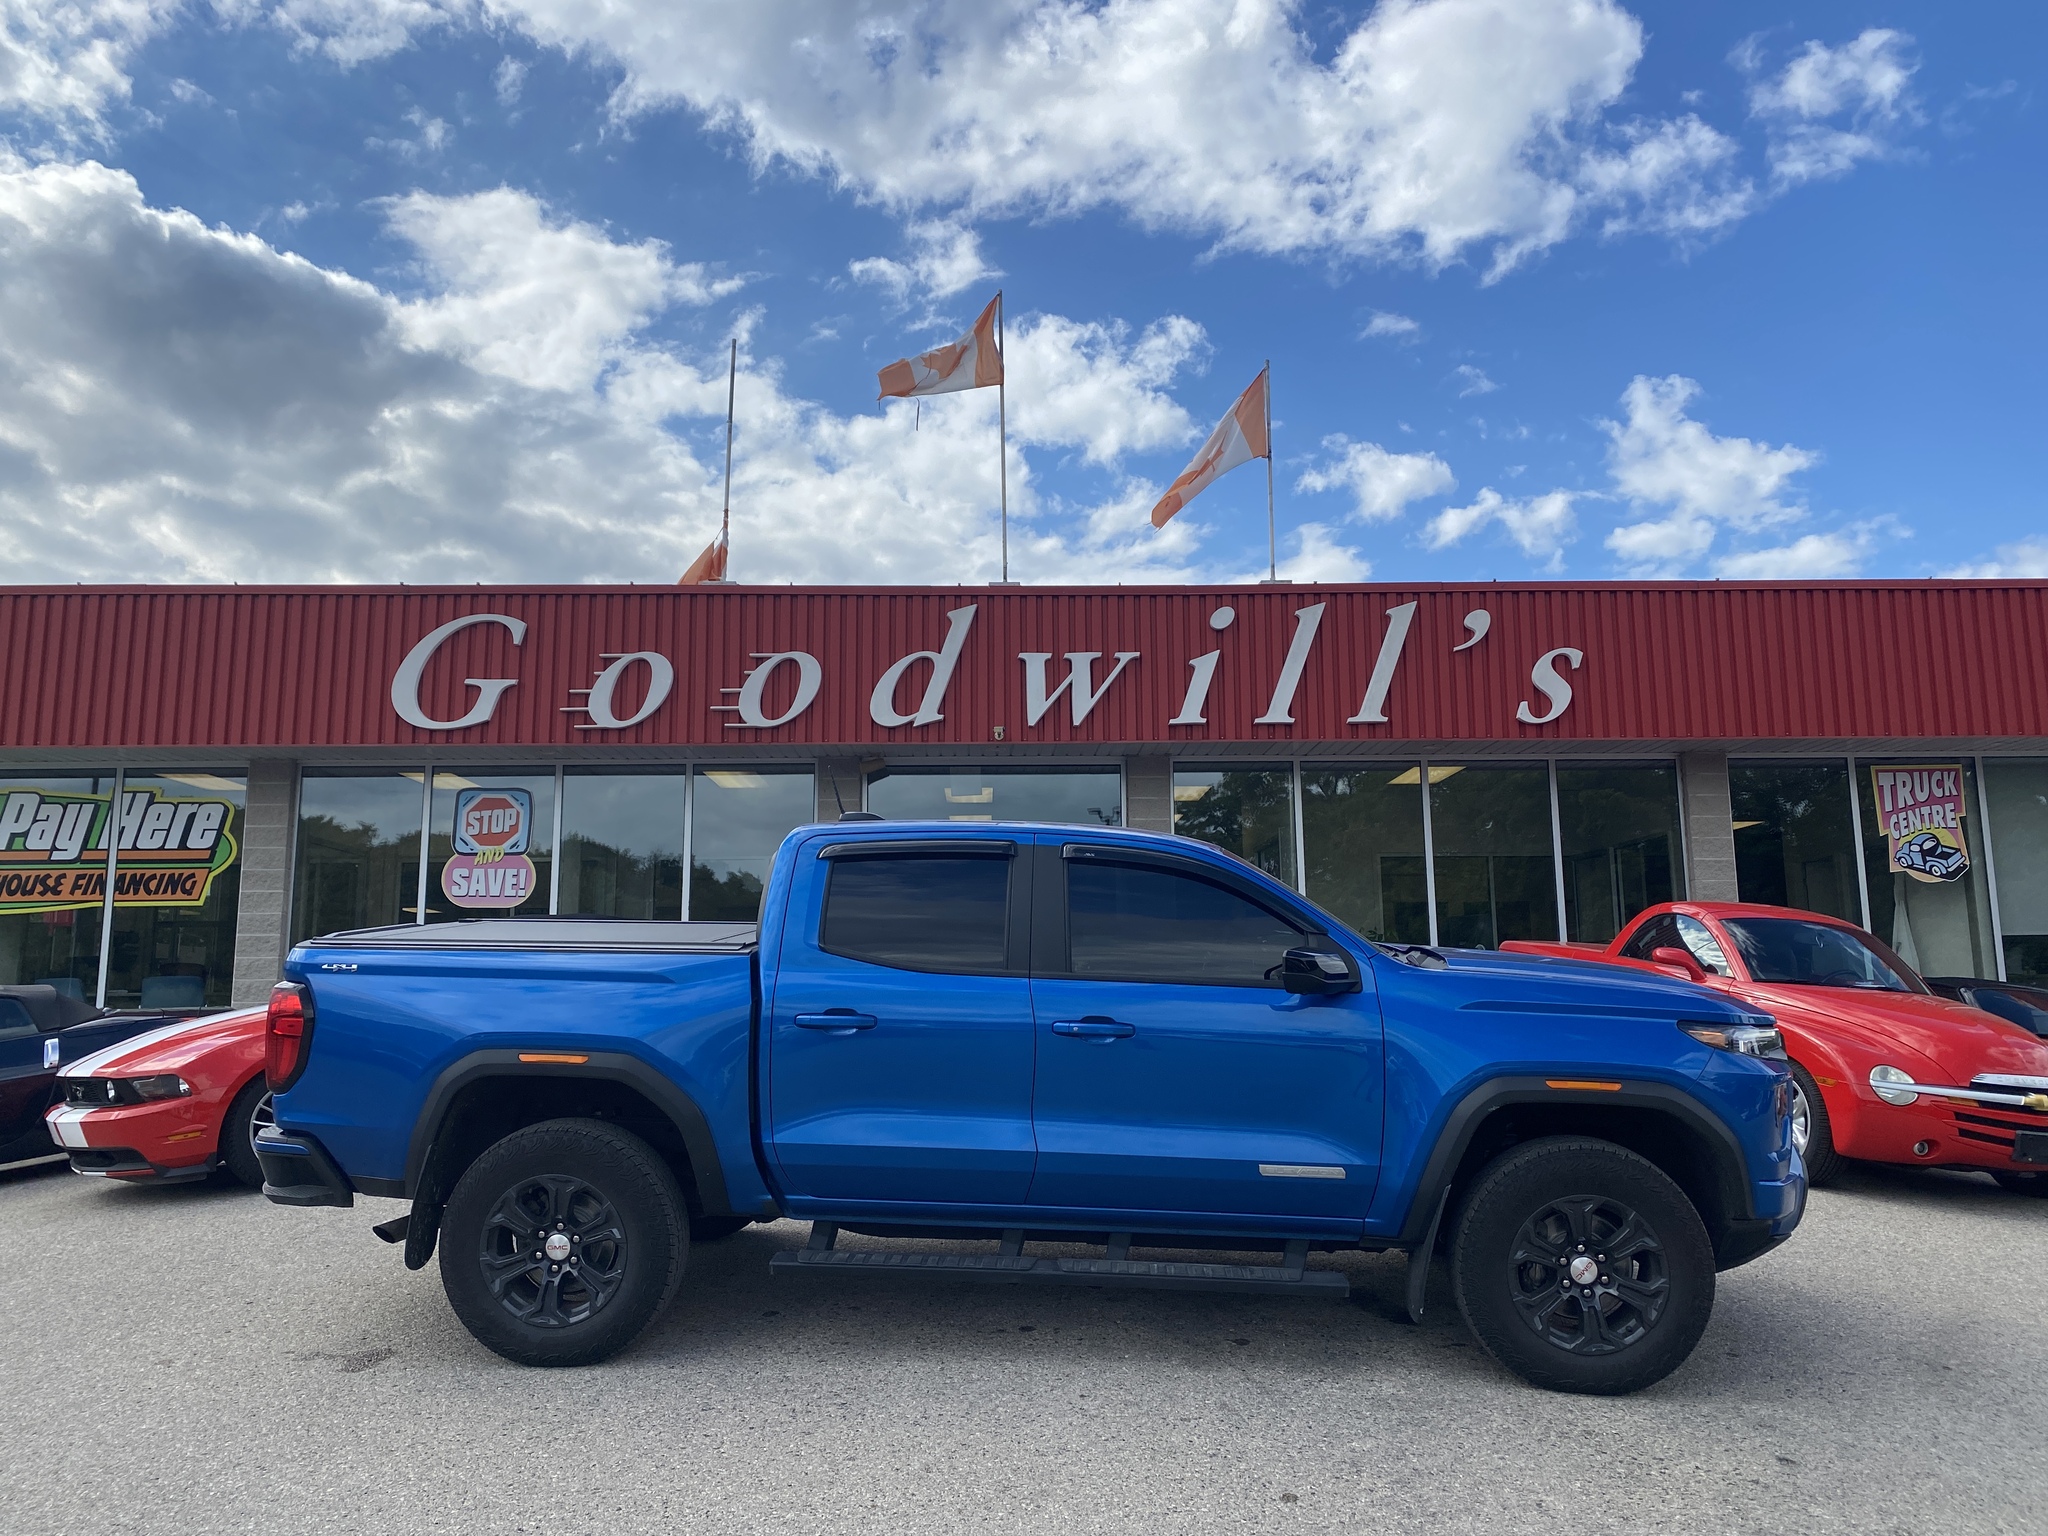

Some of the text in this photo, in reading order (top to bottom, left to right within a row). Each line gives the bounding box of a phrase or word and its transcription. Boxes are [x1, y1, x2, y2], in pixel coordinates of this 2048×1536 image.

[391, 601, 1584, 730] Goodwill's
[1878, 771, 1958, 812] TRUCK
[0, 792, 225, 860] Pay Here
[467, 808, 517, 836] STOP
[1889, 803, 1958, 840] CENTRE
[474, 847, 505, 866] AND
[69, 872, 197, 896] FINANCING
[451, 868, 527, 897] SAVE!
[1575, 1261, 1593, 1281] GMC
